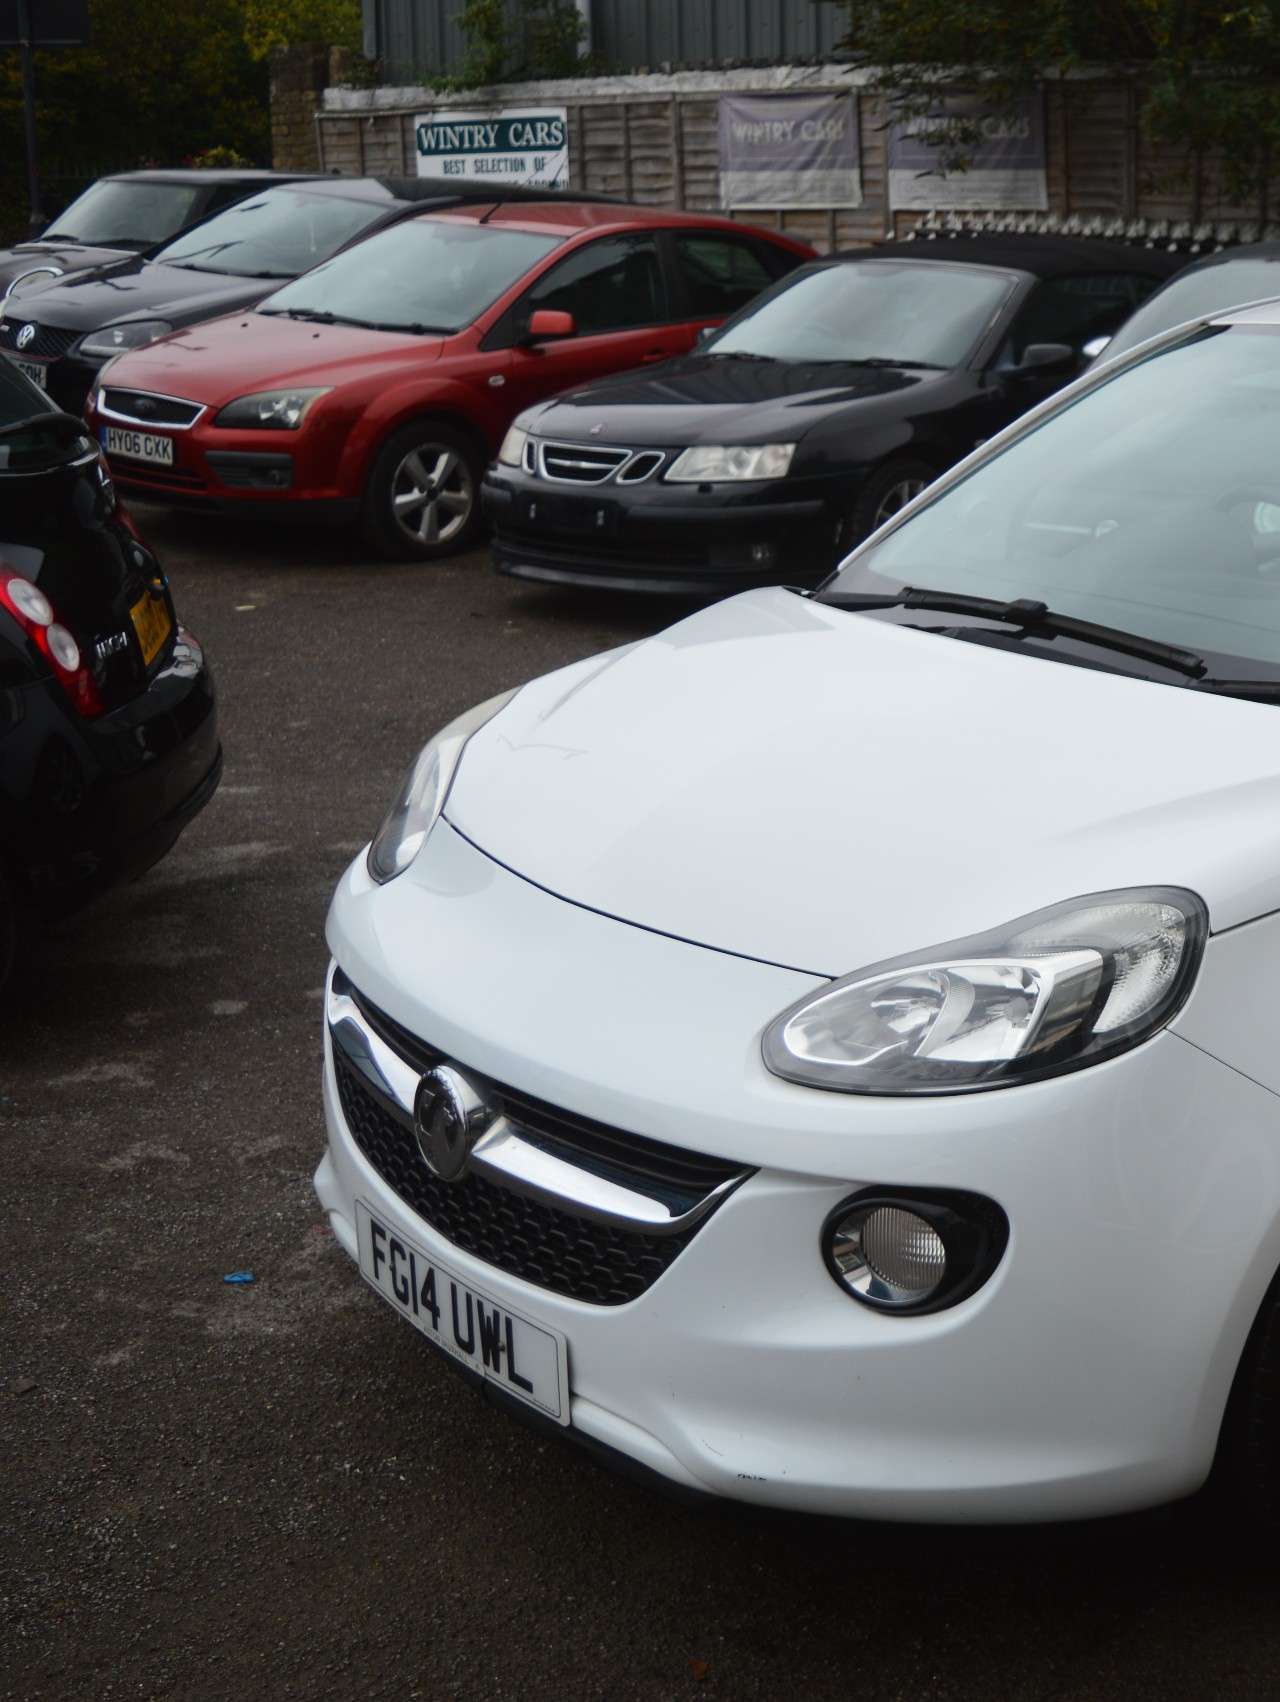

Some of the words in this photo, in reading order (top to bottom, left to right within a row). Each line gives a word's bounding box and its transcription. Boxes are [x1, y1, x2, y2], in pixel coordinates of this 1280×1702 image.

[421, 124, 498, 150] WINTRY
[510, 121, 563, 147] CARS
[732, 120, 795, 144] WINTRY
[443, 160, 465, 174] BEST
[474, 158, 526, 174] SELECTION
[534, 157, 546, 172] OF
[108, 430, 140, 454] HY06
[370, 1218, 440, 1331] FG14
[451, 1282, 533, 1394] UWL
